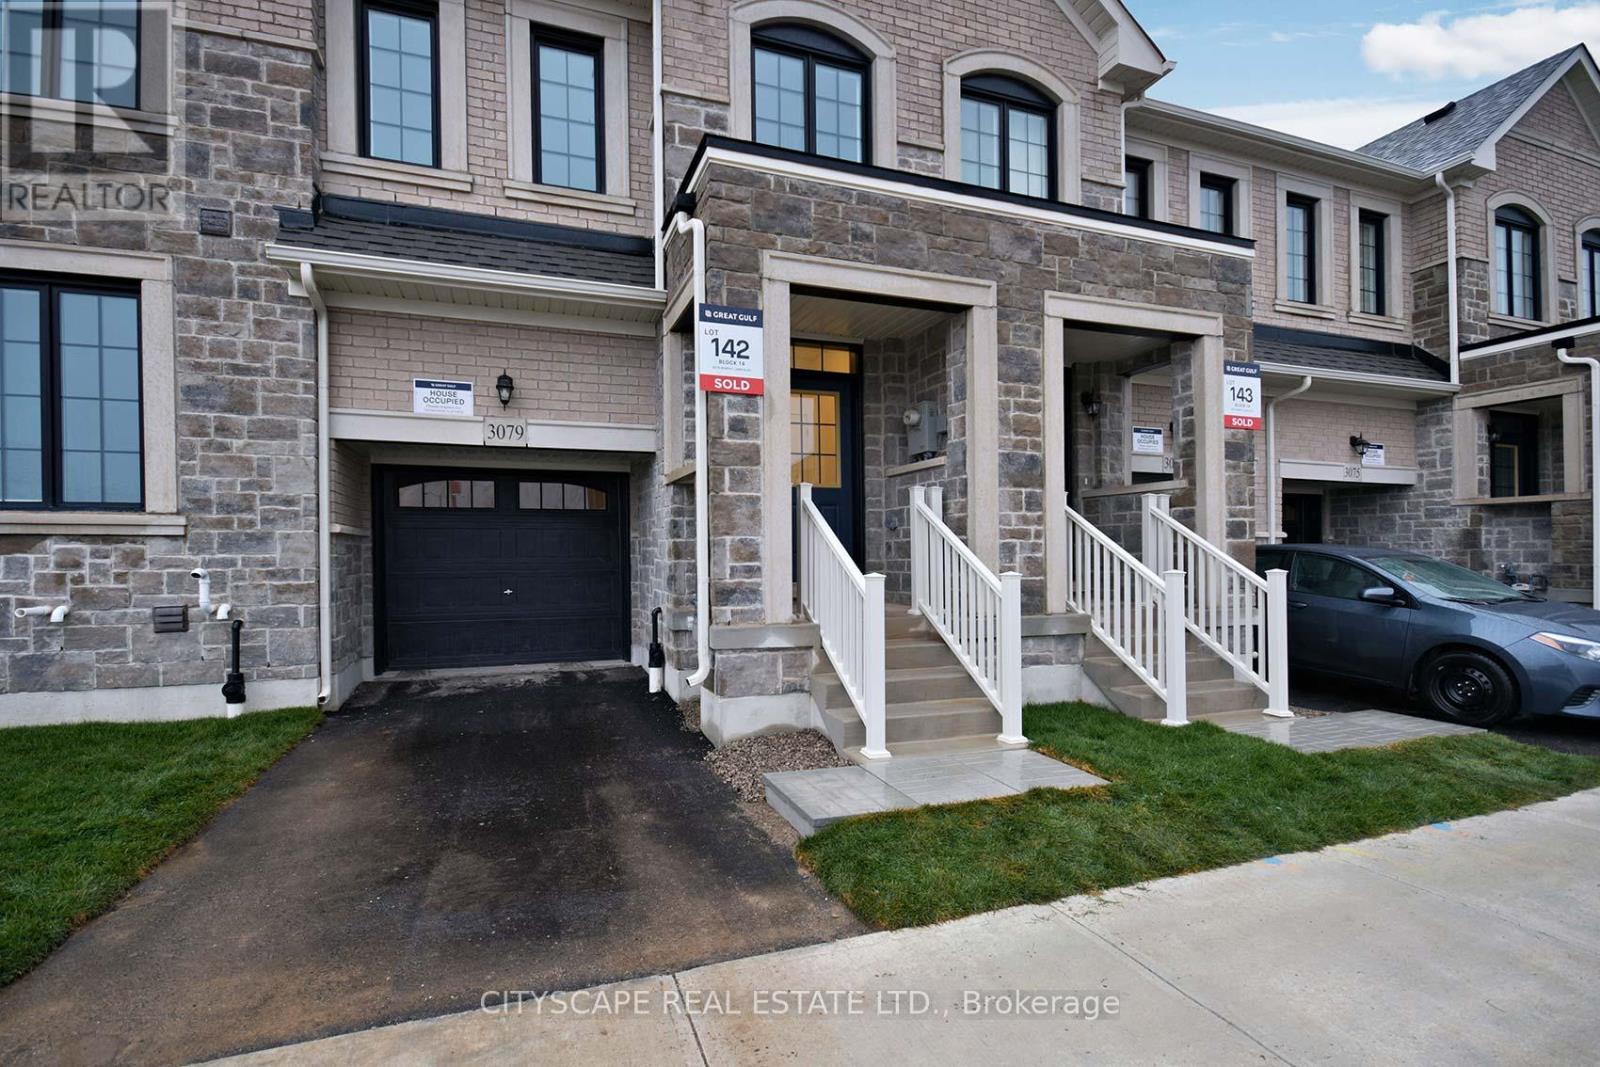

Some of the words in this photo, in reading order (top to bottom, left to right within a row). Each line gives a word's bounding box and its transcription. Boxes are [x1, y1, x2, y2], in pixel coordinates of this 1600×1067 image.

[713, 311, 737, 320] GREAT
[711, 337, 750, 360] 142
[714, 378, 750, 391] SOLD
[429, 390, 457, 398] HOUSE
[1230, 386, 1254, 403] 143
[423, 397, 465, 405] OCCUPIED
[1232, 417, 1254, 427] SOLD
[487, 424, 524, 441] 3079
